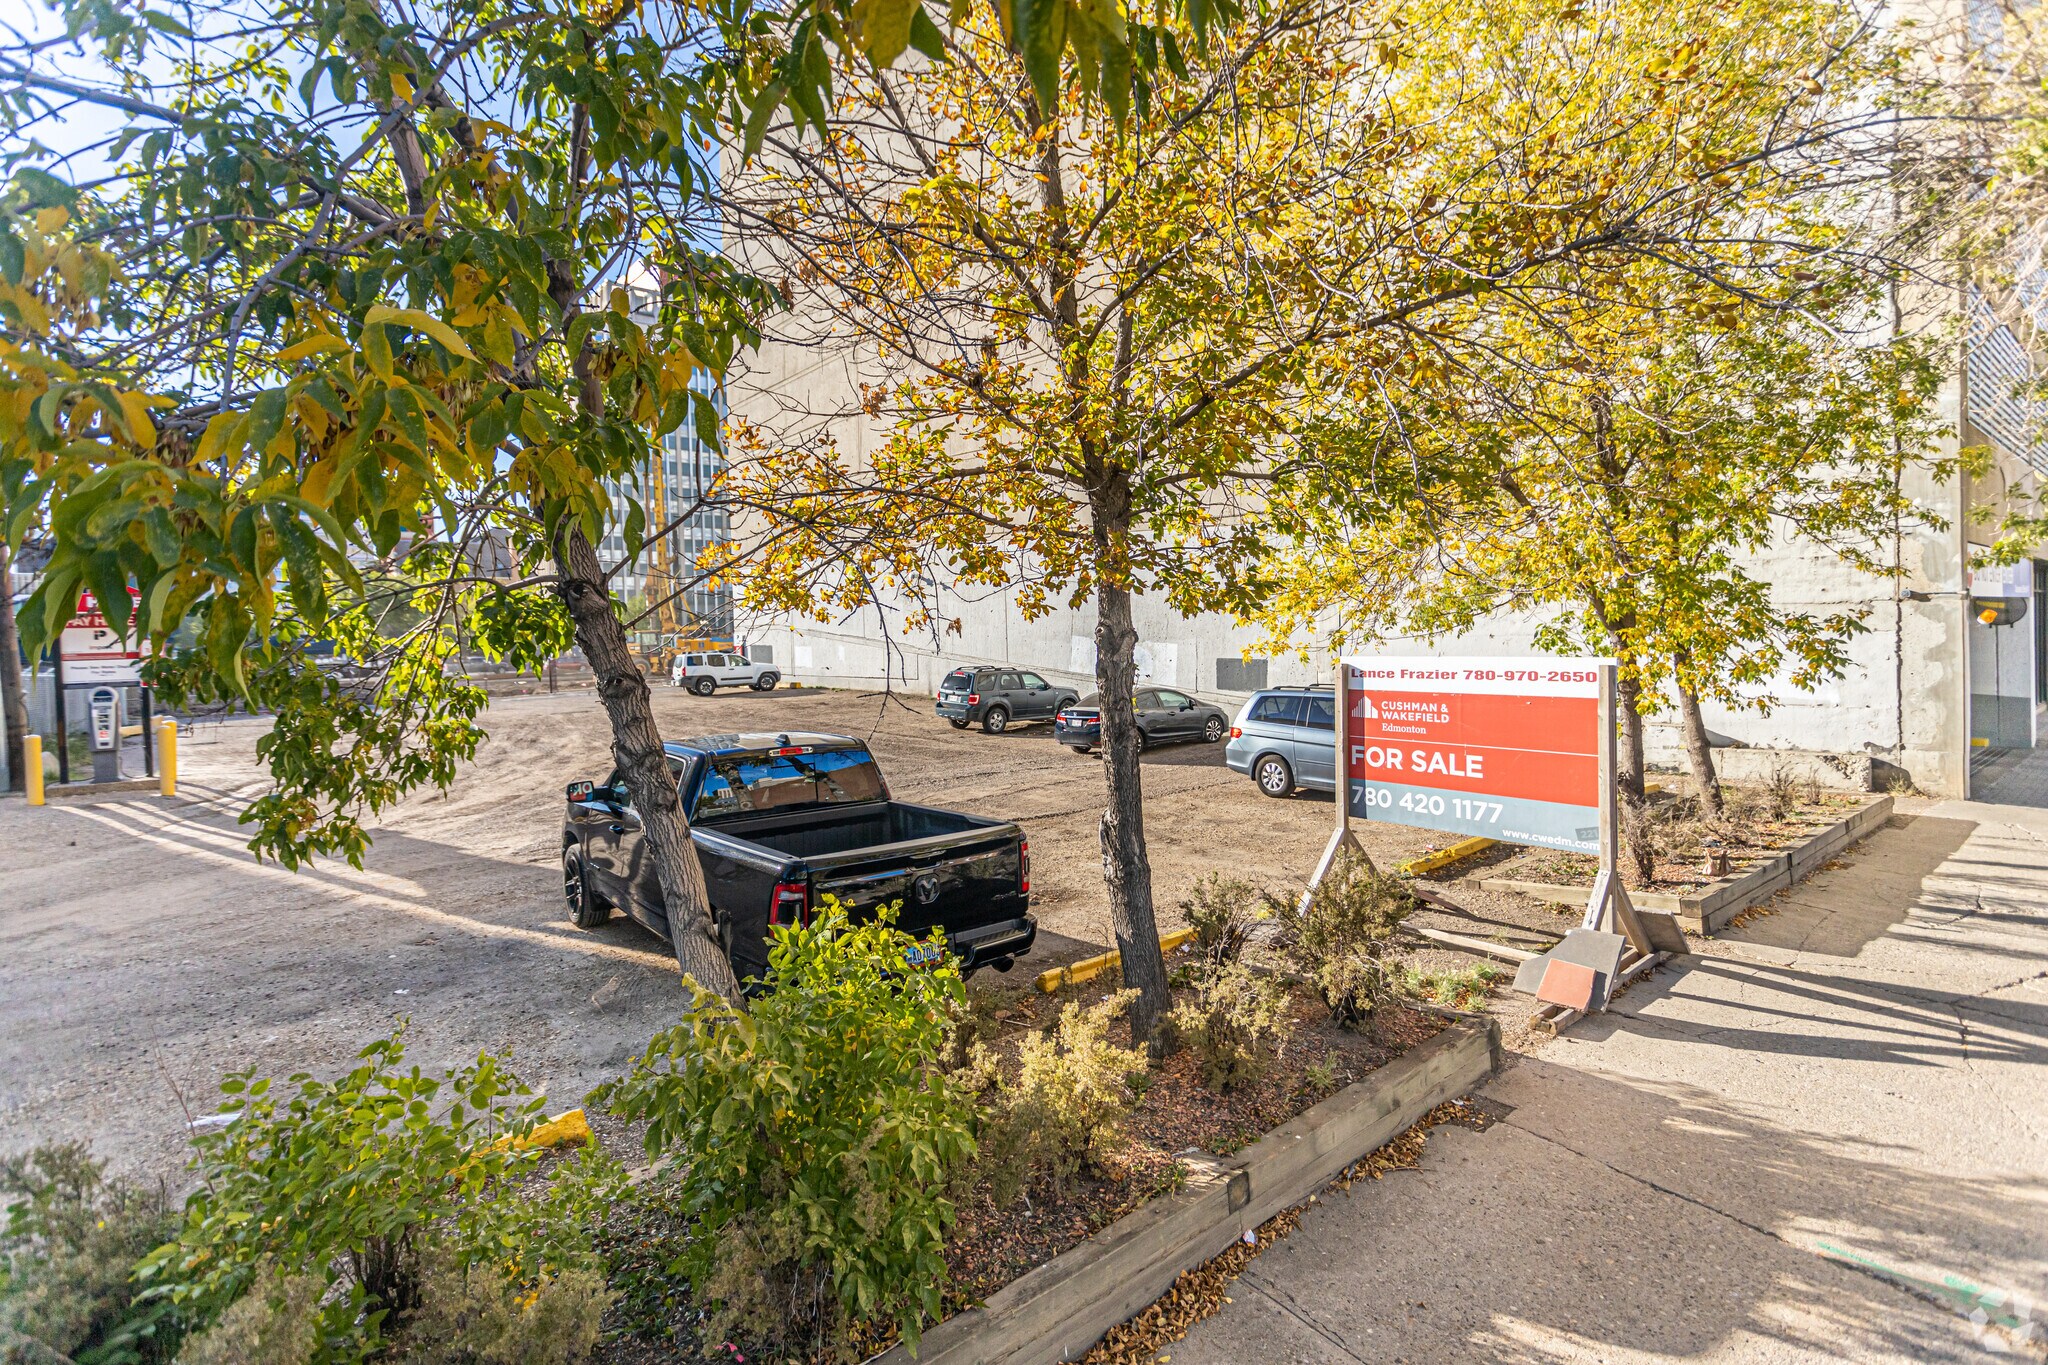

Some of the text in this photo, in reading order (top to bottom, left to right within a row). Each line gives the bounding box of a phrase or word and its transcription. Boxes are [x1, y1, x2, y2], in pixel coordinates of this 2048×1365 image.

[1351, 668, 1598, 683] Lance Frazier 780-970-2650
[1381, 701, 1449, 713] CUSHMAN &
[1381, 711, 1450, 723] WAKEFIELD
[1382, 722, 1427, 734] Edmonton
[1351, 744, 1484, 779] FOR SALE
[1352, 785, 1504, 824] 780 420 1177
[1502, 829, 1600, 851] www.cwedm.com
